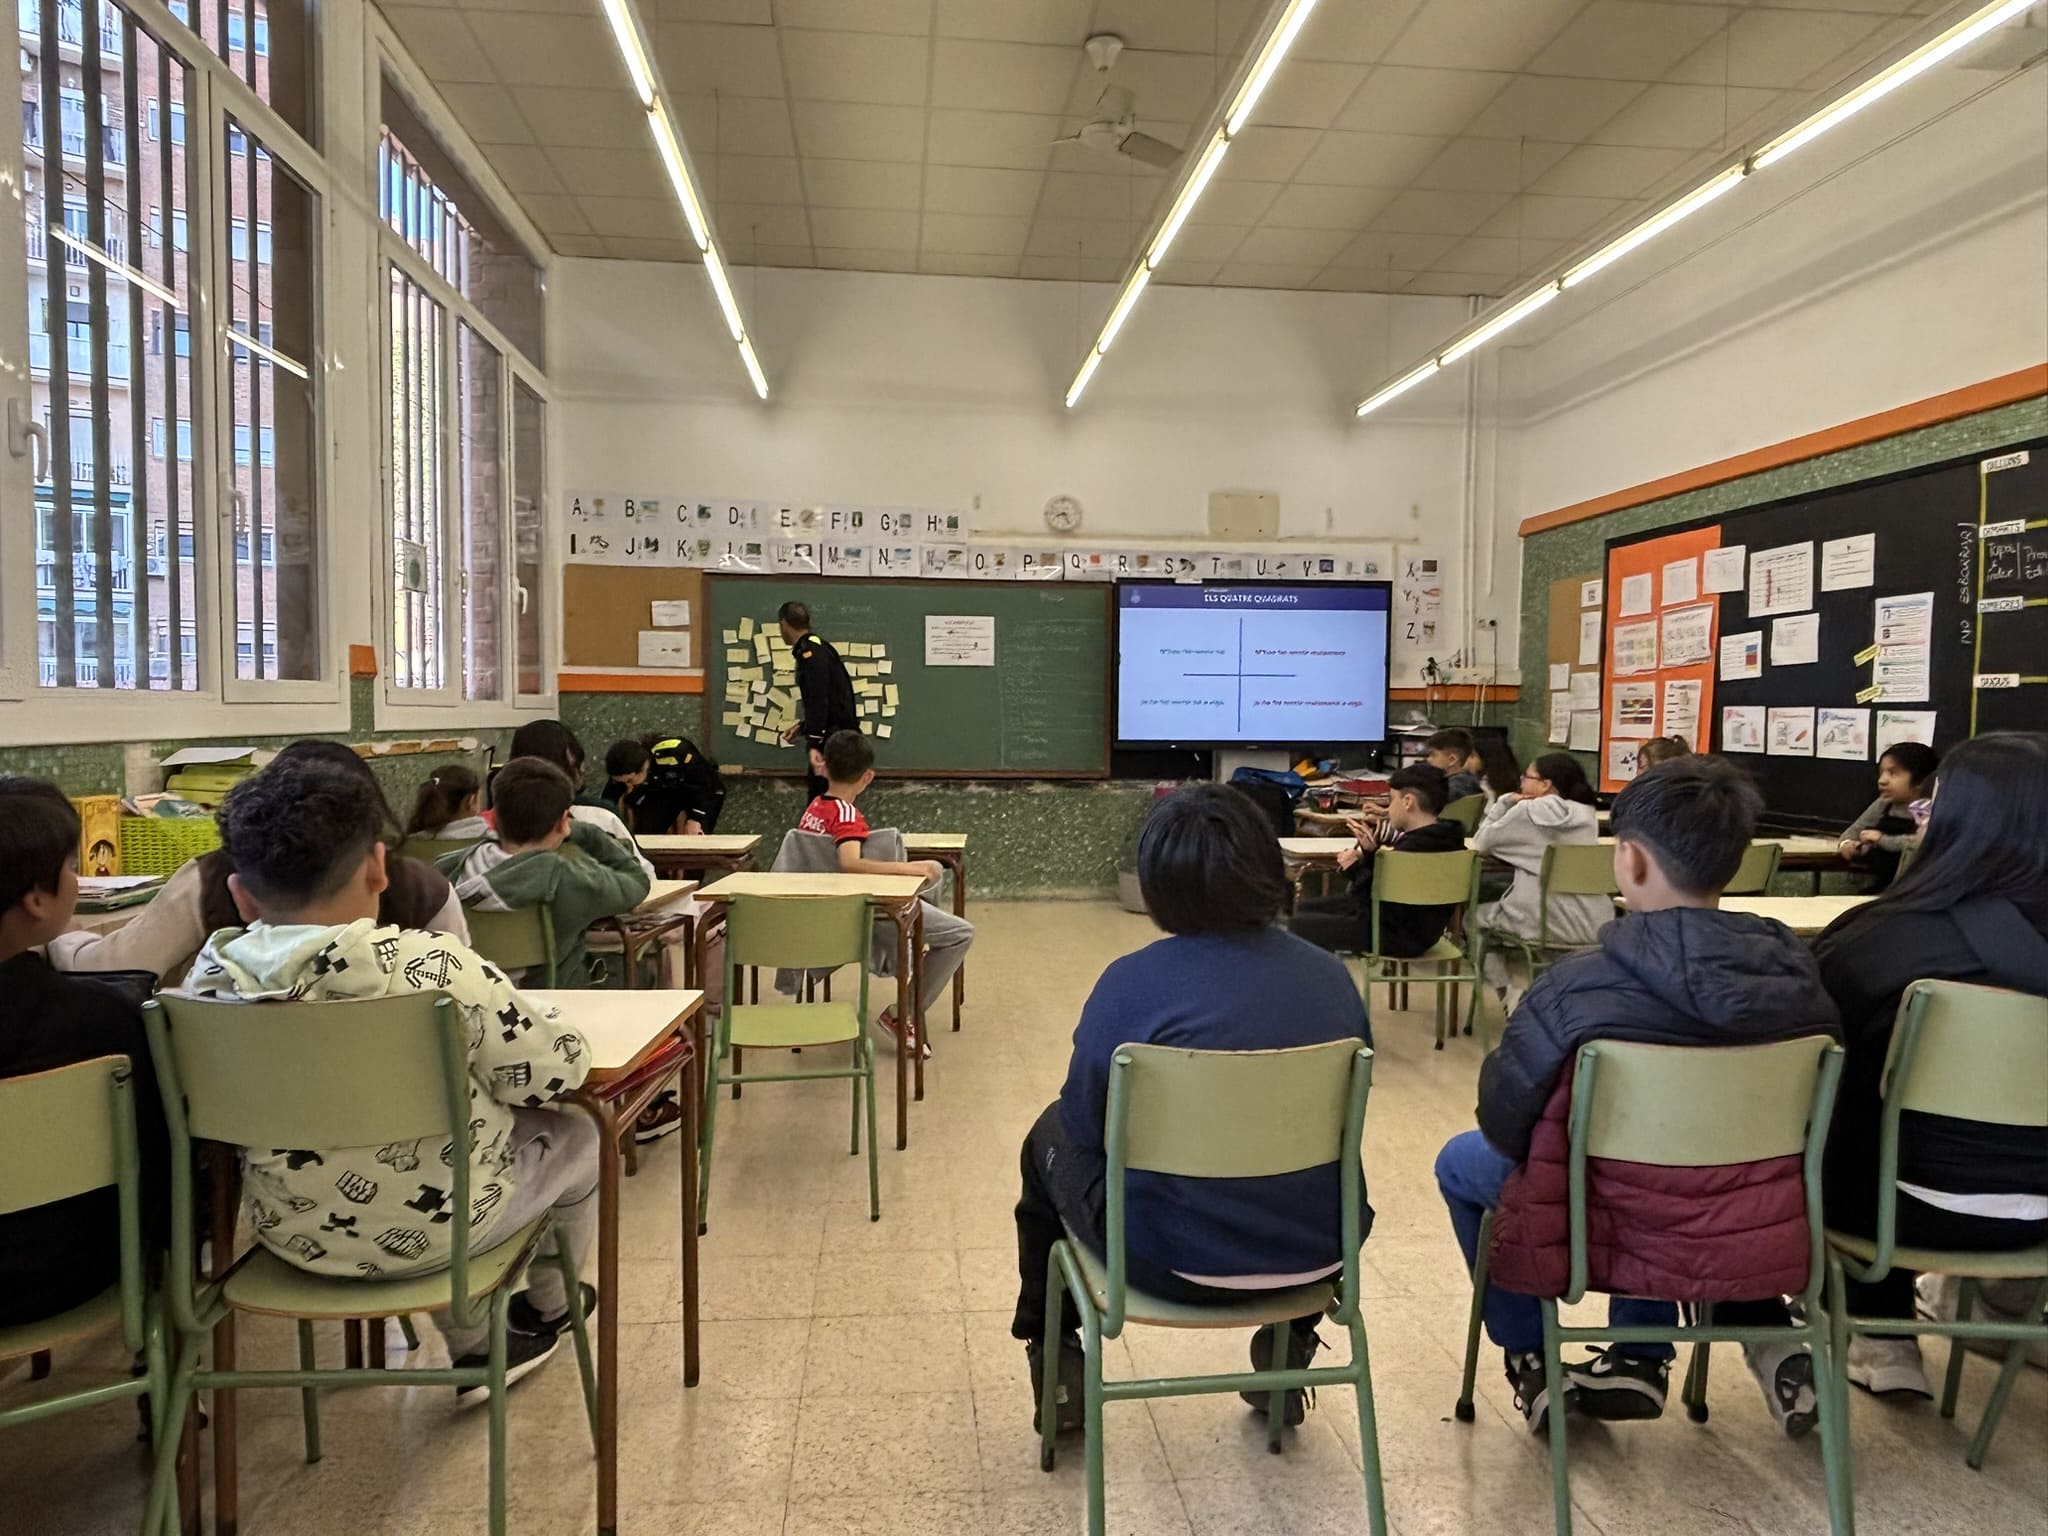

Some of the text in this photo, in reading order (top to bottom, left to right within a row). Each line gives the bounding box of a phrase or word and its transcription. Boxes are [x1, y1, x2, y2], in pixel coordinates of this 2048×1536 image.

[572, 498, 937, 532] A B C D E F G H
[625, 537, 635, 555] J
[677, 539, 687, 557] K
[878, 548, 889, 565] N
[975, 553, 984, 570] O
[1023, 554, 1032, 572] P
[1071, 554, 1080, 569] Q
[1119, 555, 1127, 572] R
[1164, 557, 1174, 574] S
[1212, 557, 1221, 574] T
[1257, 559, 1266, 575] U
[1406, 622, 1416, 639] Z
